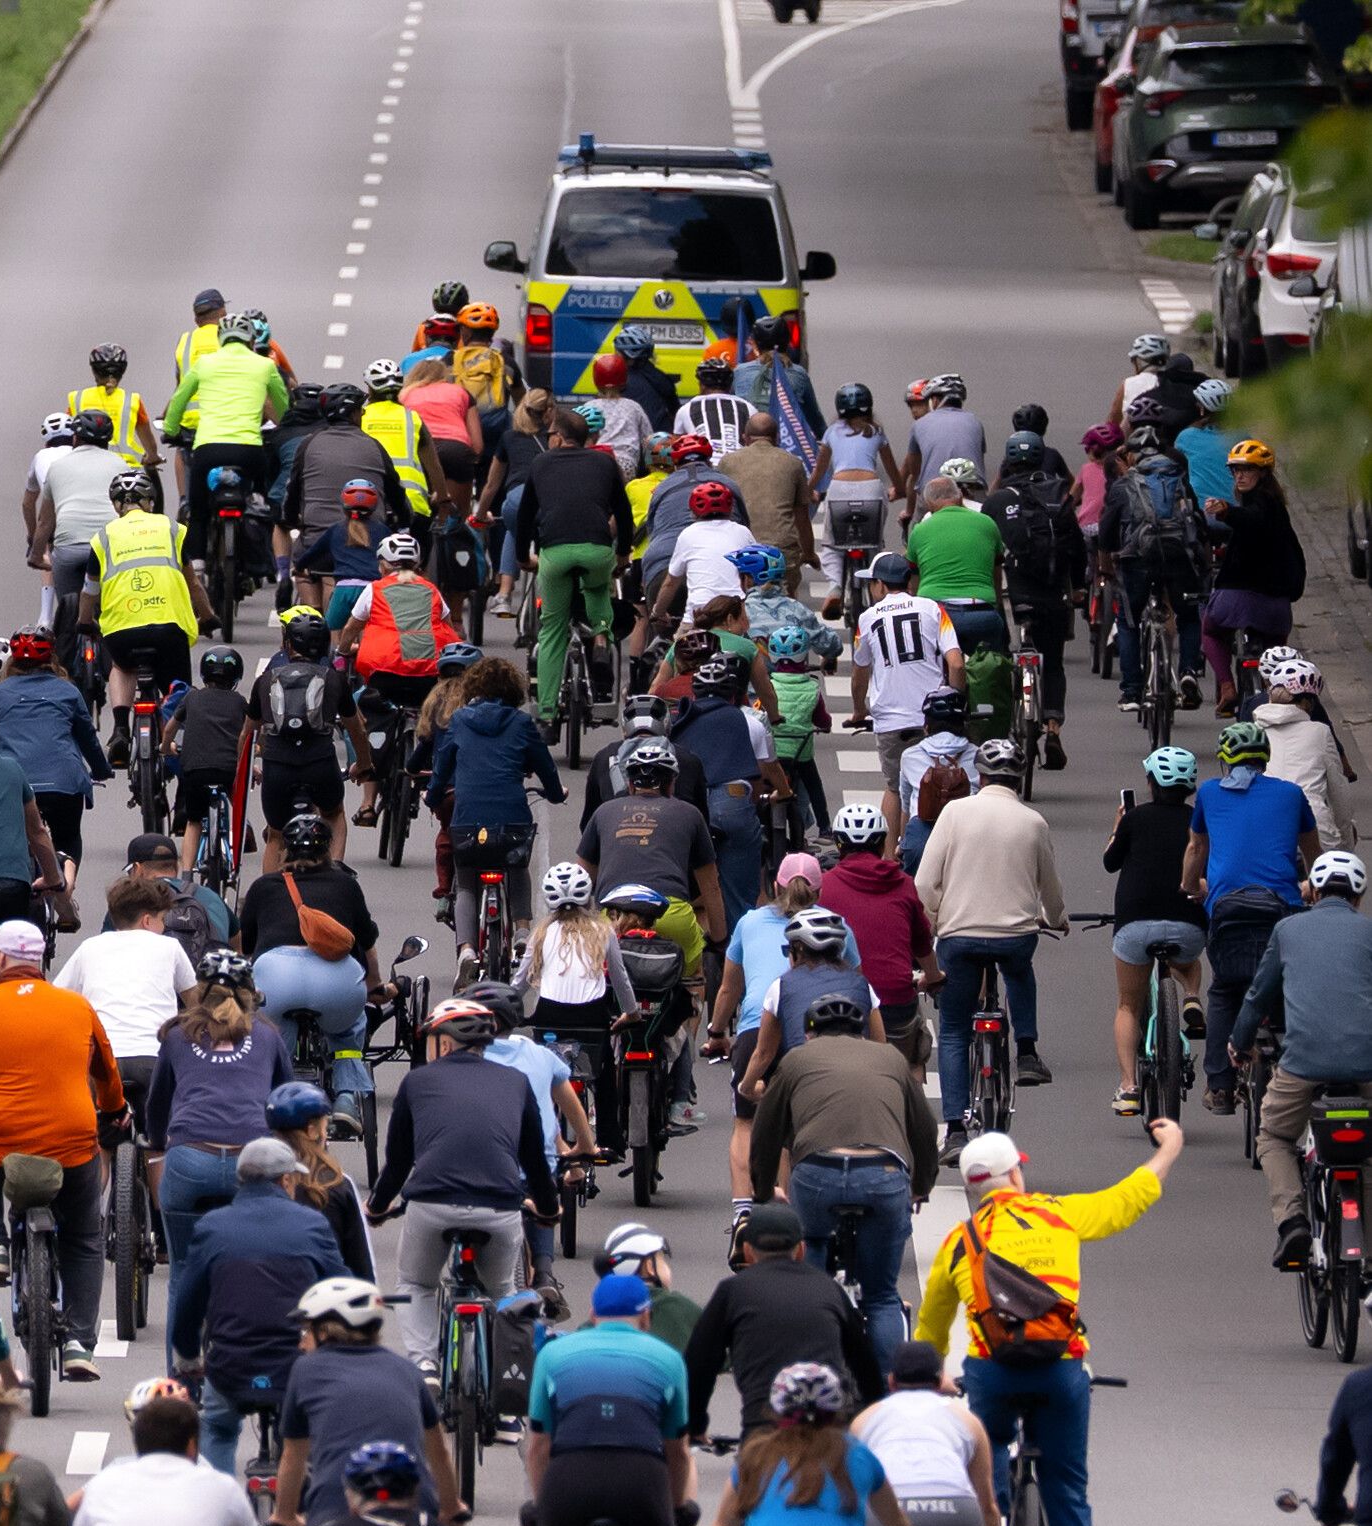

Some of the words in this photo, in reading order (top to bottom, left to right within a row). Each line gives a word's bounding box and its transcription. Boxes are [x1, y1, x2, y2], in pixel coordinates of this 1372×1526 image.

[568, 293, 623, 308] POLIZEI
[143, 596, 166, 606] adfc
[870, 612, 927, 667] 10
[907, 1499, 956, 1514] RYSEL
